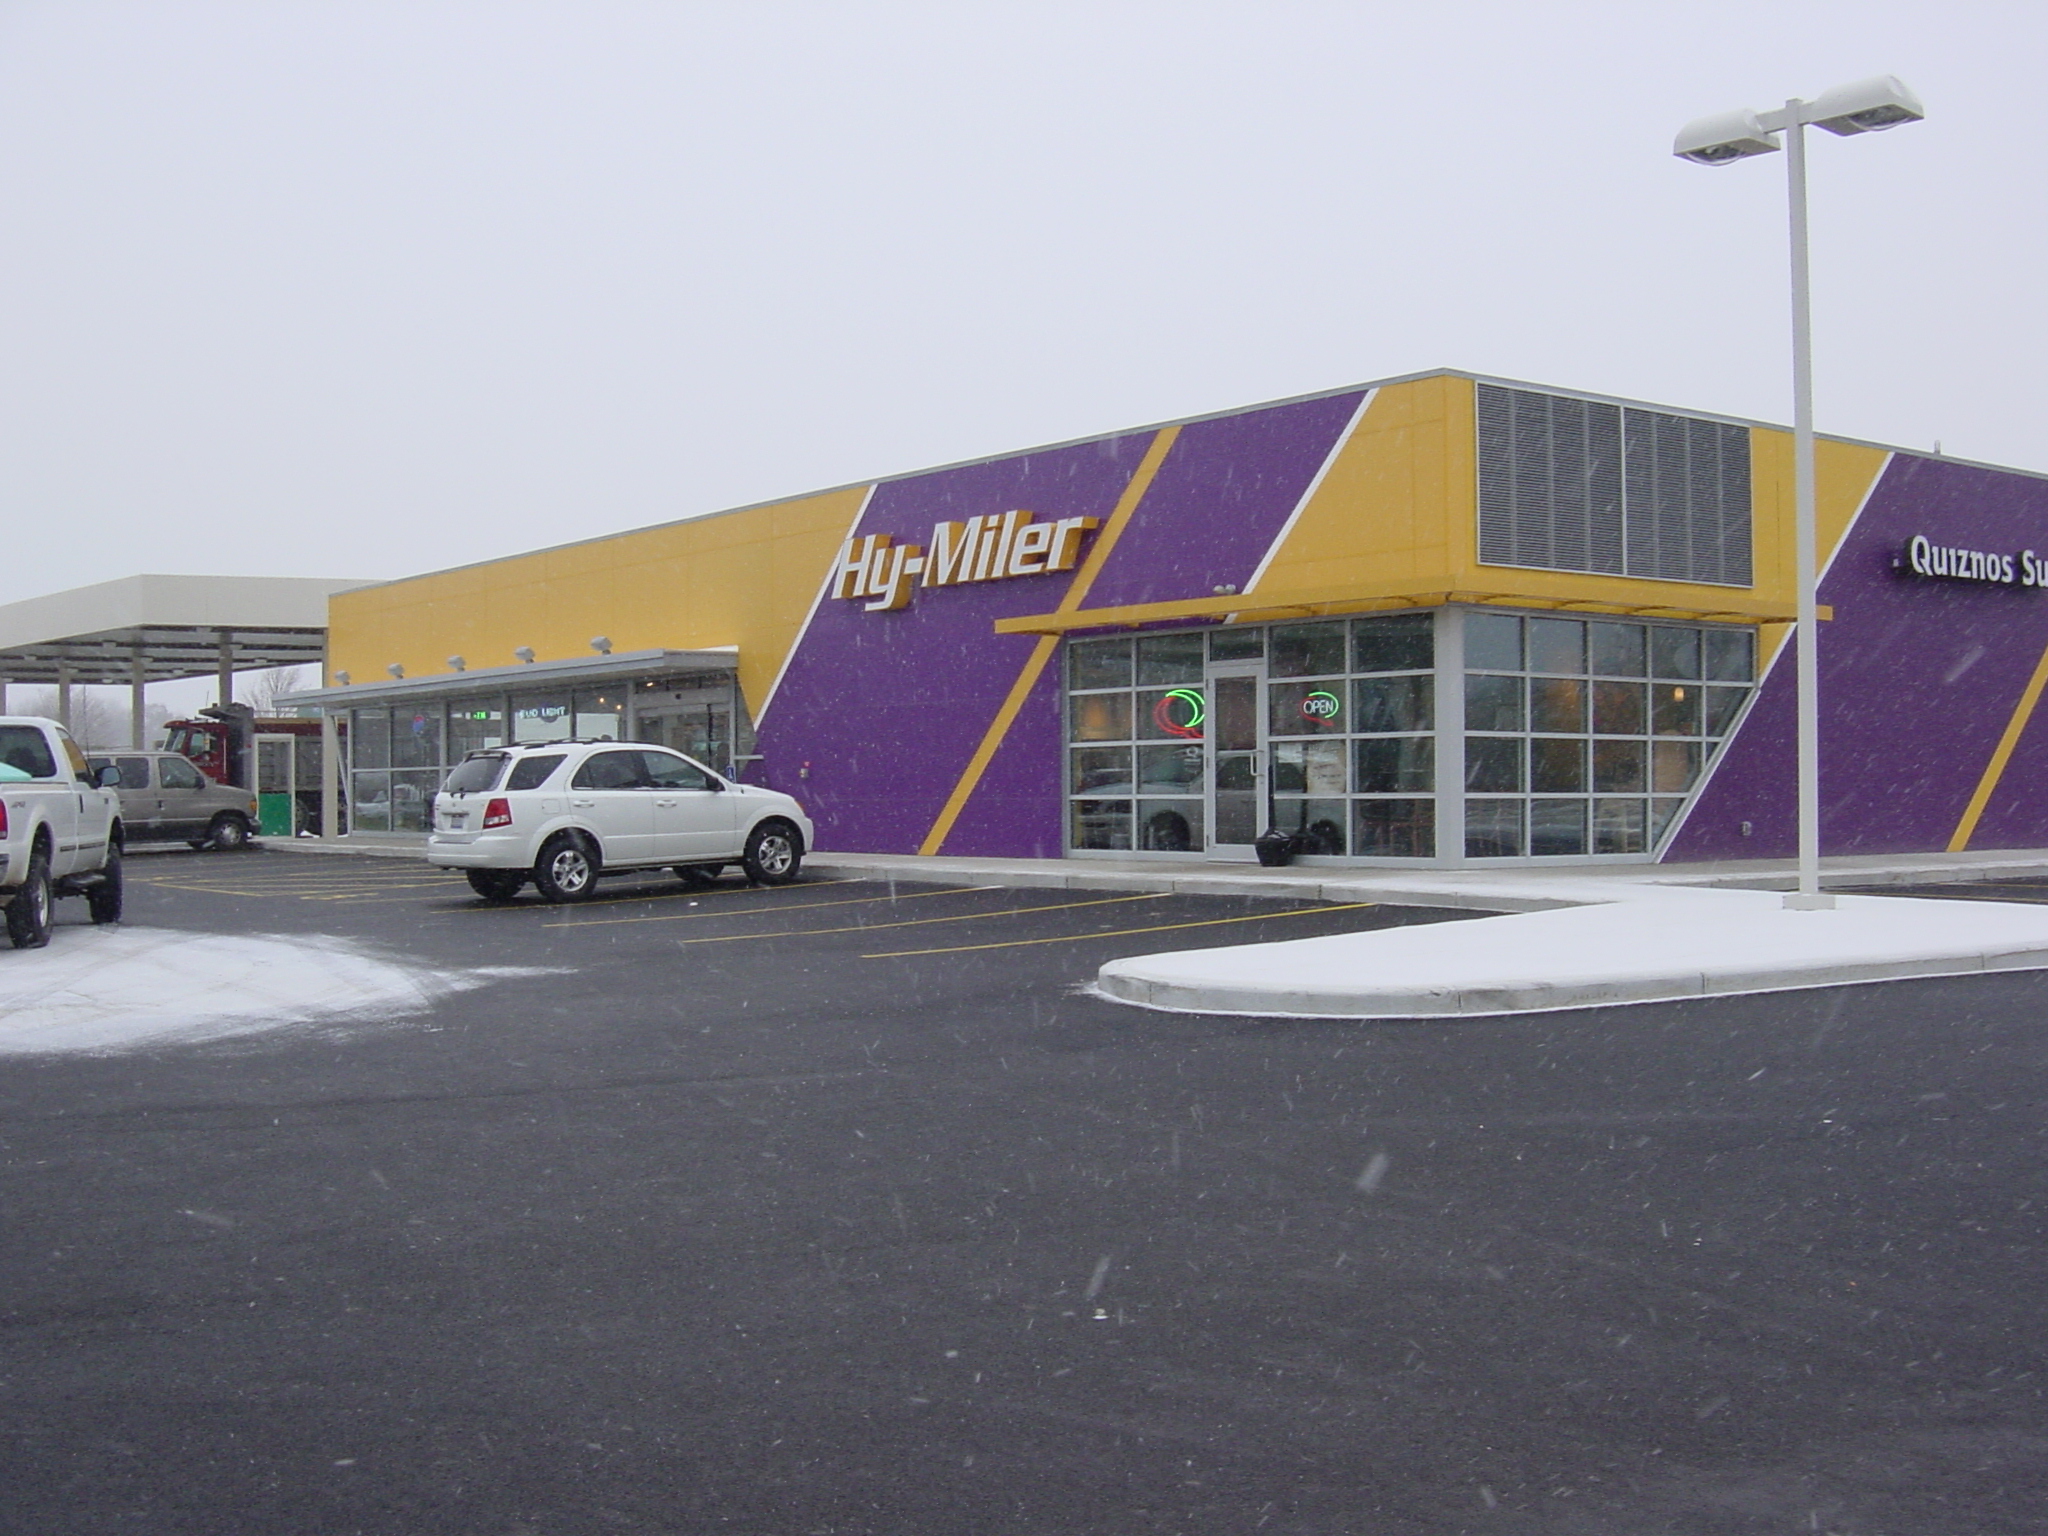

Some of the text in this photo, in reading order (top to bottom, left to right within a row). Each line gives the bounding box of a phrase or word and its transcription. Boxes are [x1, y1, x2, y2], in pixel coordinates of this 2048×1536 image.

[831, 509, 1092, 612] Hy-Miler
[1911, 534, 2013, 583] Quiznos
[1303, 699, 1333, 714] OPEN
